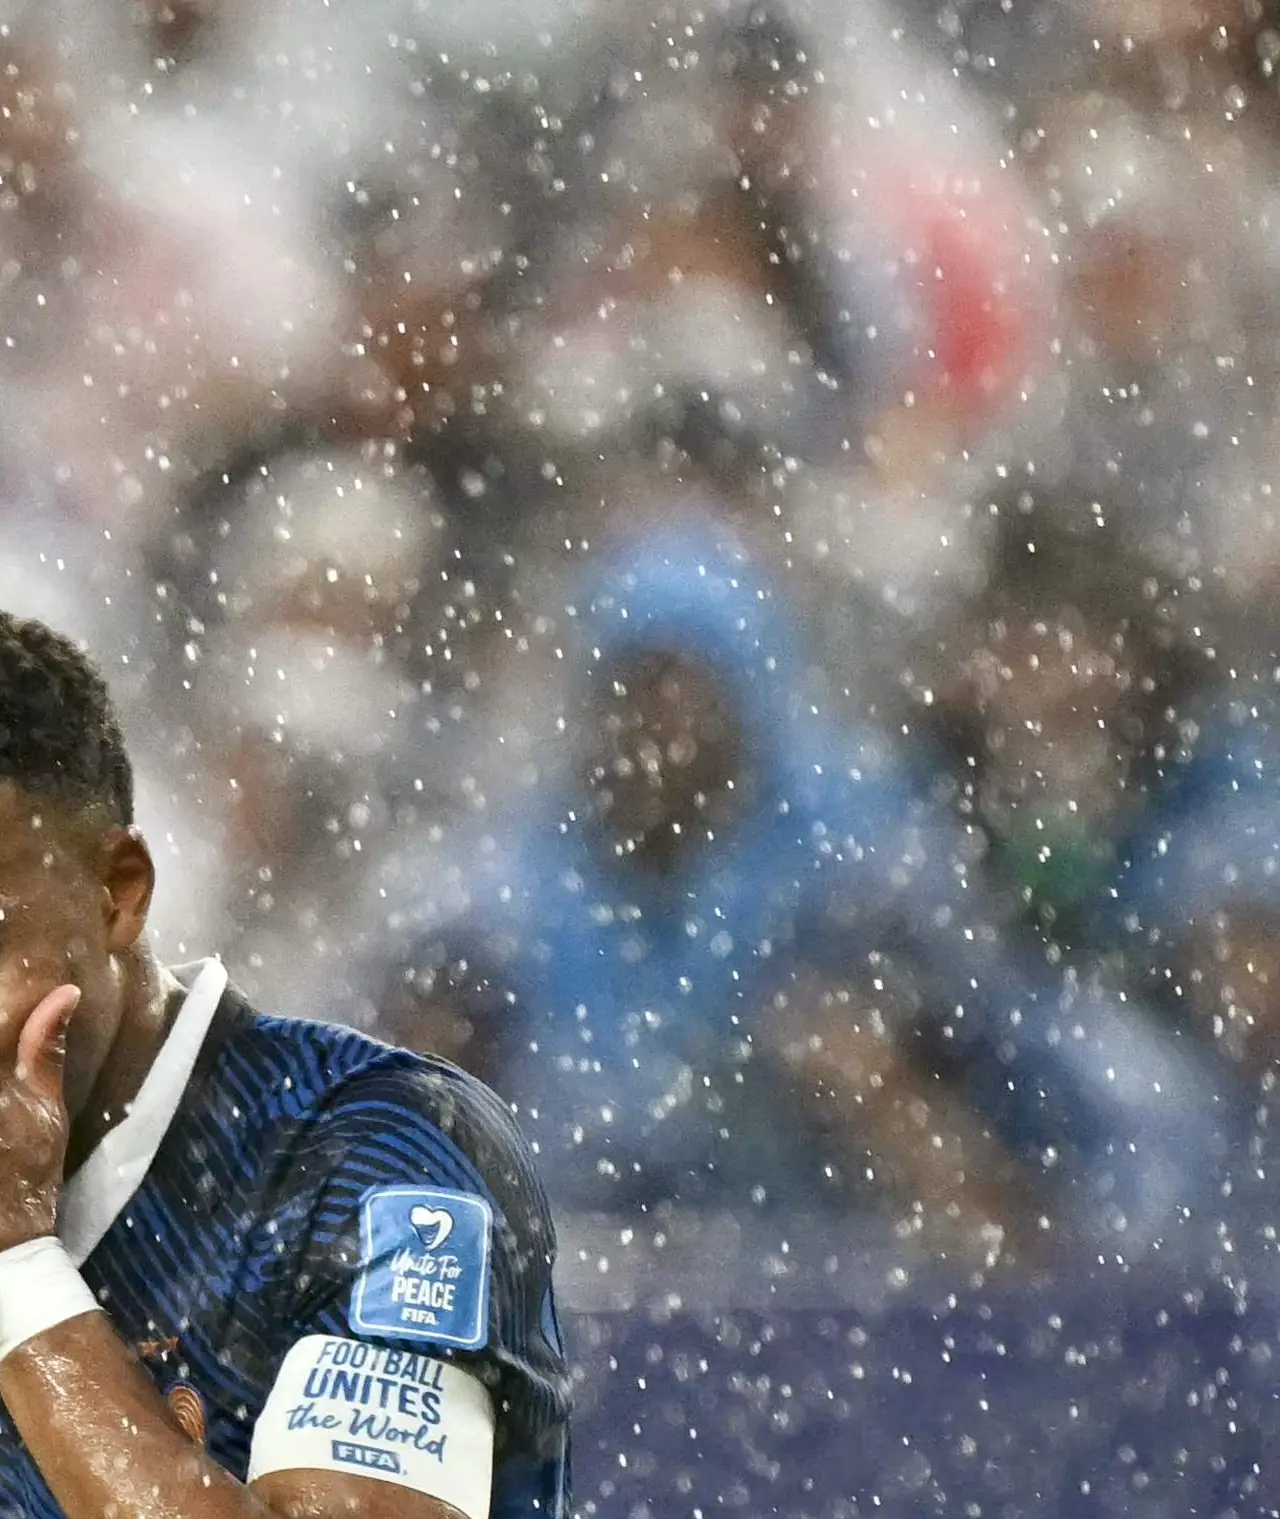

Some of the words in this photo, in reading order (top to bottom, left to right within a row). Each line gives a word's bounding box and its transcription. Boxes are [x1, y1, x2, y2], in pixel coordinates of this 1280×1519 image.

[438, 1255, 464, 1281] For
[391, 1275, 456, 1311] PEACE
[401, 1306, 439, 1326] FIFA
[316, 1341, 444, 1392] FOOTBALL
[303, 1367, 441, 1425] UNITES
[286, 1402, 341, 1430] the
[348, 1408, 448, 1463] World
[336, 1443, 398, 1471] FIFA
